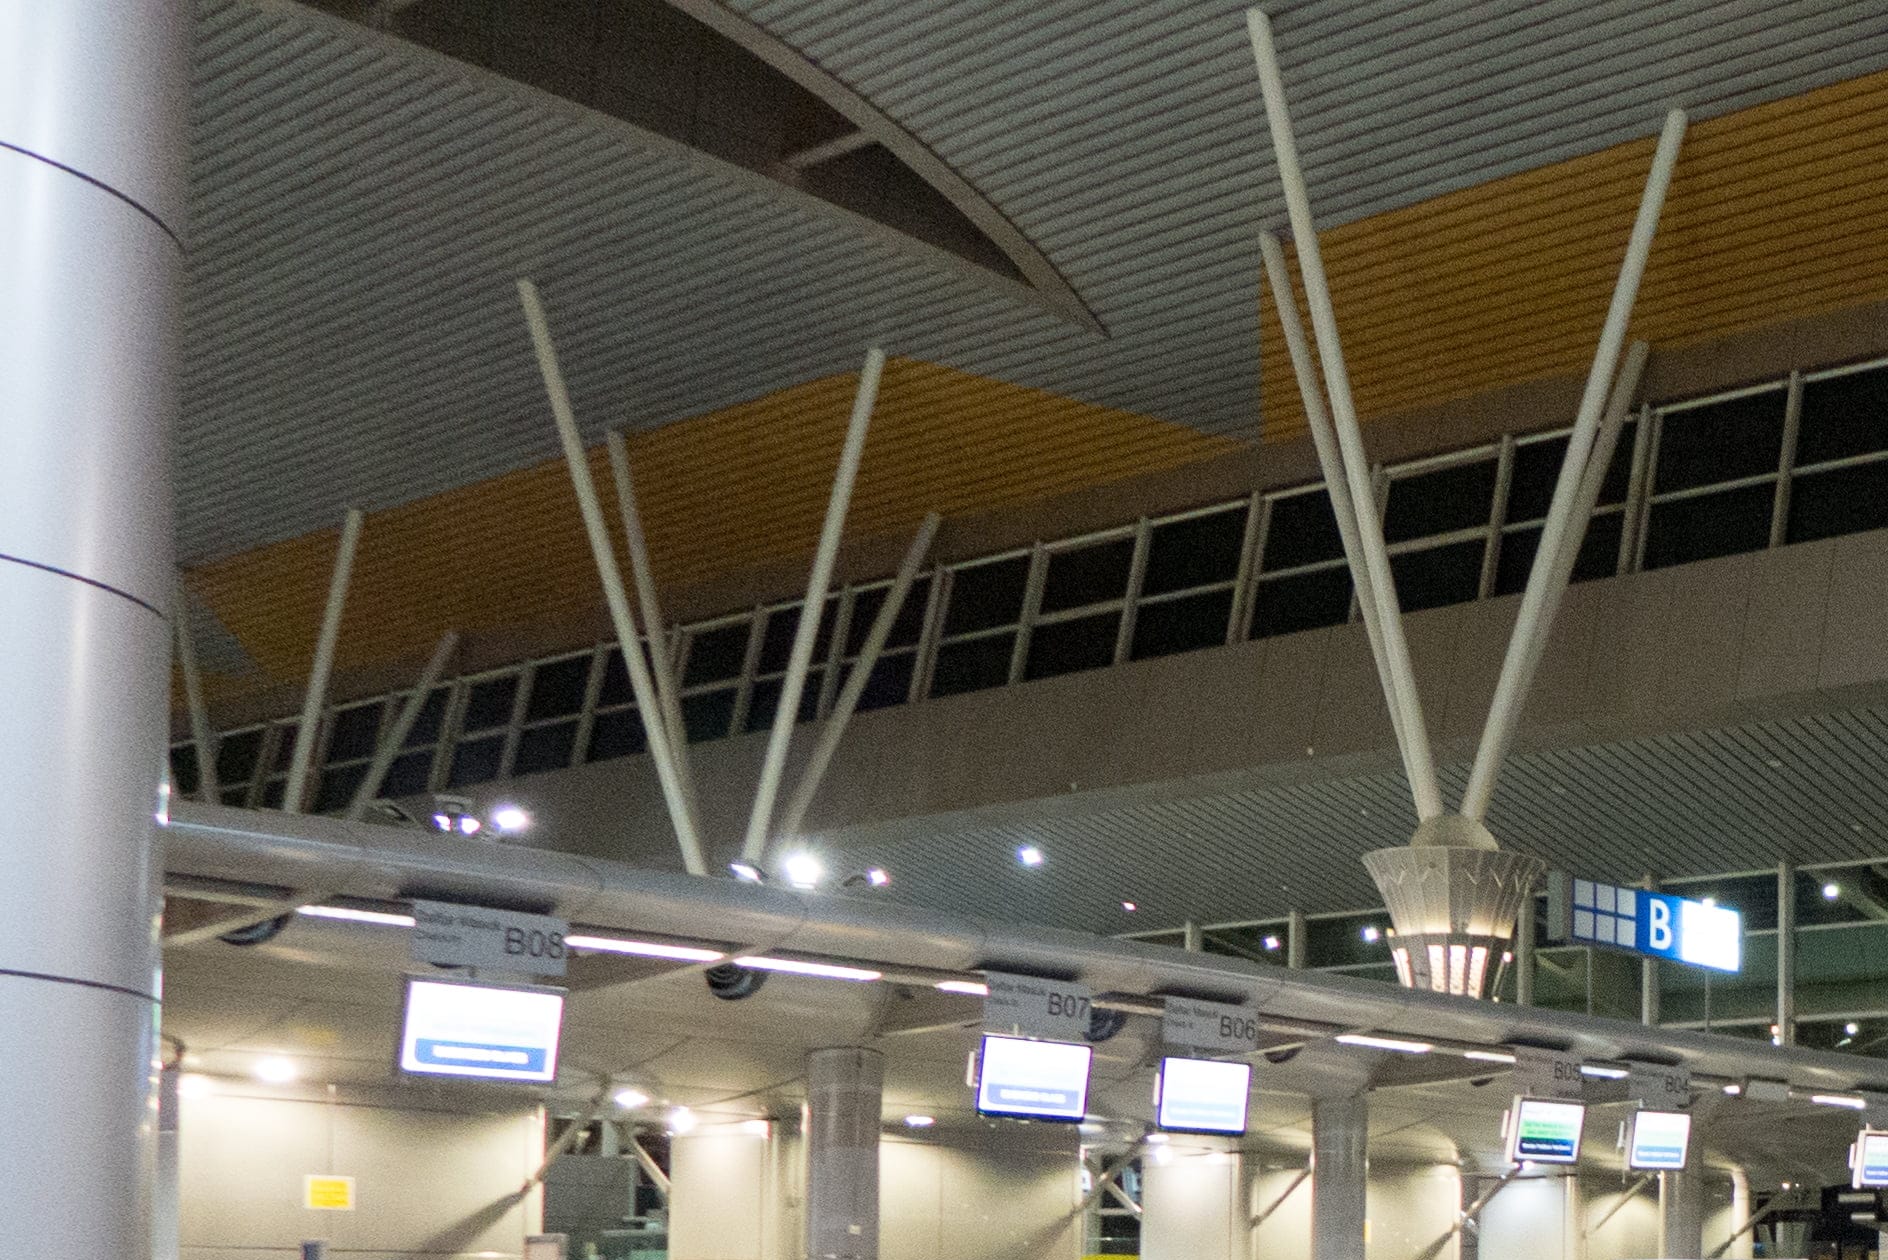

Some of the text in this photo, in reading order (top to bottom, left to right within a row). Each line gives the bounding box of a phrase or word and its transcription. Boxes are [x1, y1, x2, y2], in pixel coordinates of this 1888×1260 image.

[1650, 898, 1672, 950] B
[504, 927, 564, 959] B08
[1048, 992, 1089, 1019] B07
[1220, 1016, 1256, 1040] B06
